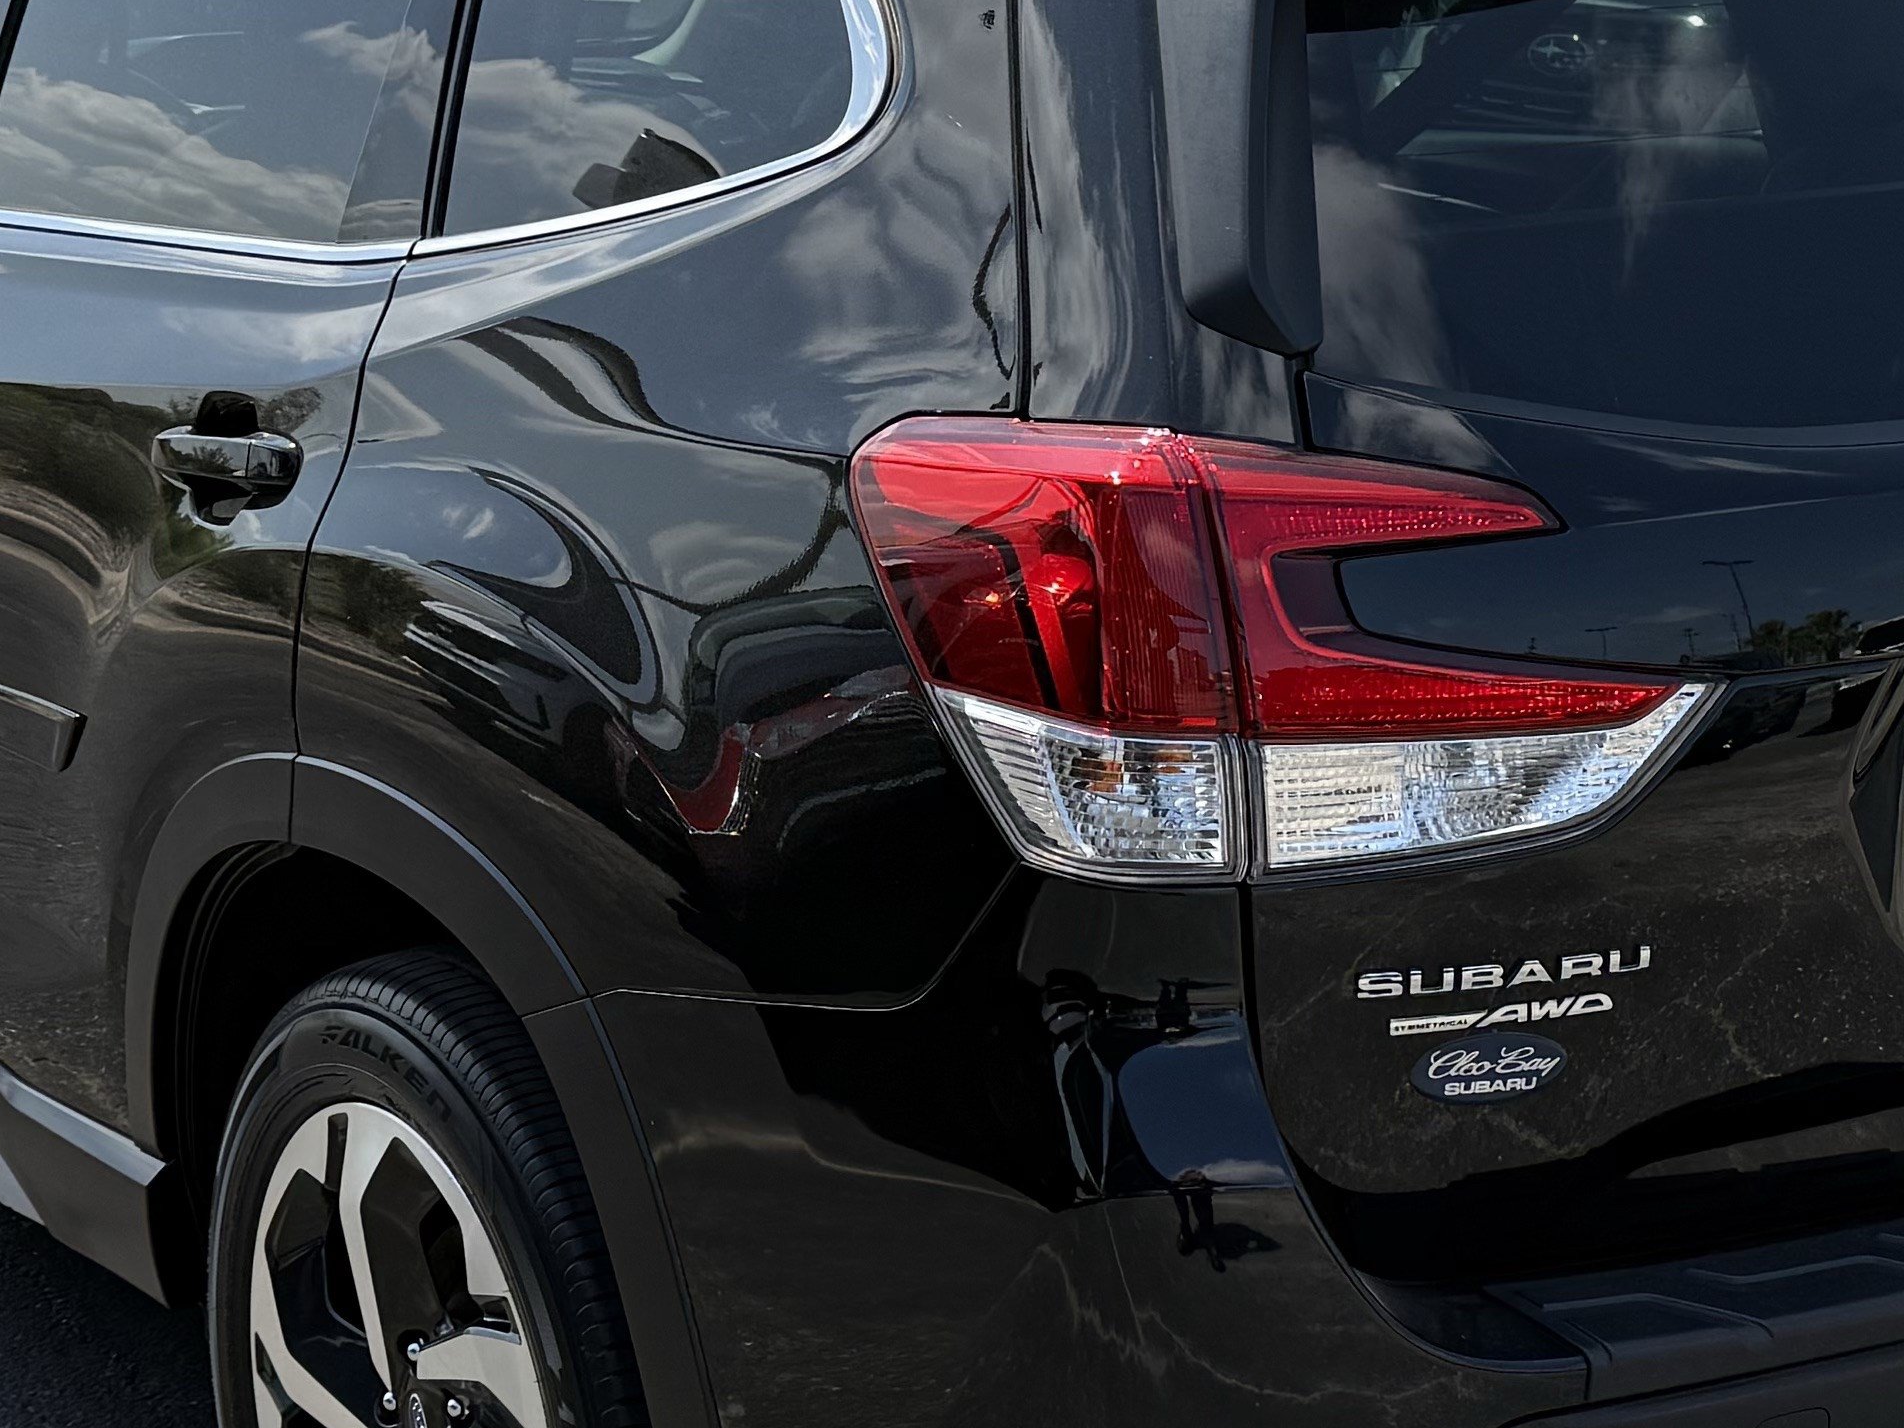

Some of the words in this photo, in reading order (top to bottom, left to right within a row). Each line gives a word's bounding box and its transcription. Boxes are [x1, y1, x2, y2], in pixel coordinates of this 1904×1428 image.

[1356, 945, 1651, 1000] SUBARU
[1475, 992, 1614, 1029] AWD
[1427, 1048, 1497, 1080] Cleo
[1495, 1045, 1562, 1077] Bay
[1443, 1075, 1538, 1097] SUBARU
